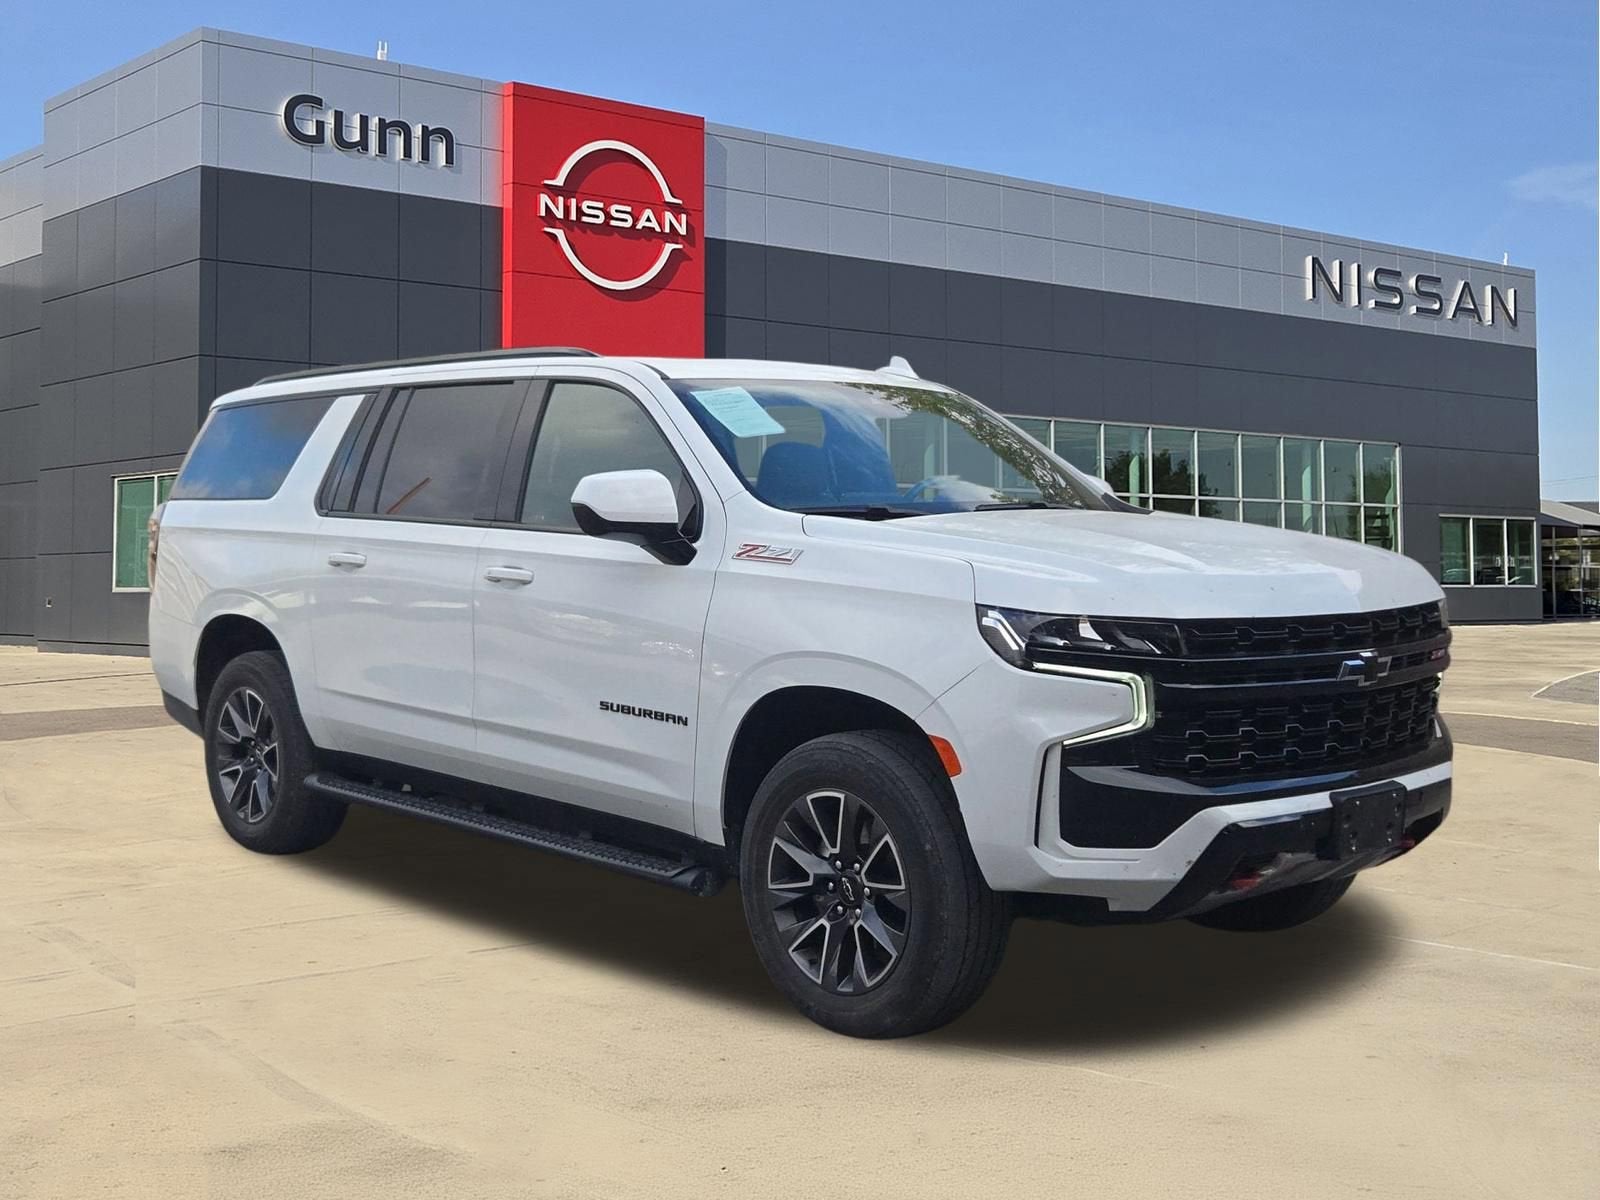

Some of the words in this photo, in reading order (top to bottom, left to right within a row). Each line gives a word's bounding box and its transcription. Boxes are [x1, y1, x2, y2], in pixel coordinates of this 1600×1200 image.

[282, 93, 455, 167] Gunn
[537, 193, 688, 236] NISSAN
[1305, 255, 1518, 328] NISSAN
[599, 700, 688, 726] SUBURBAN
